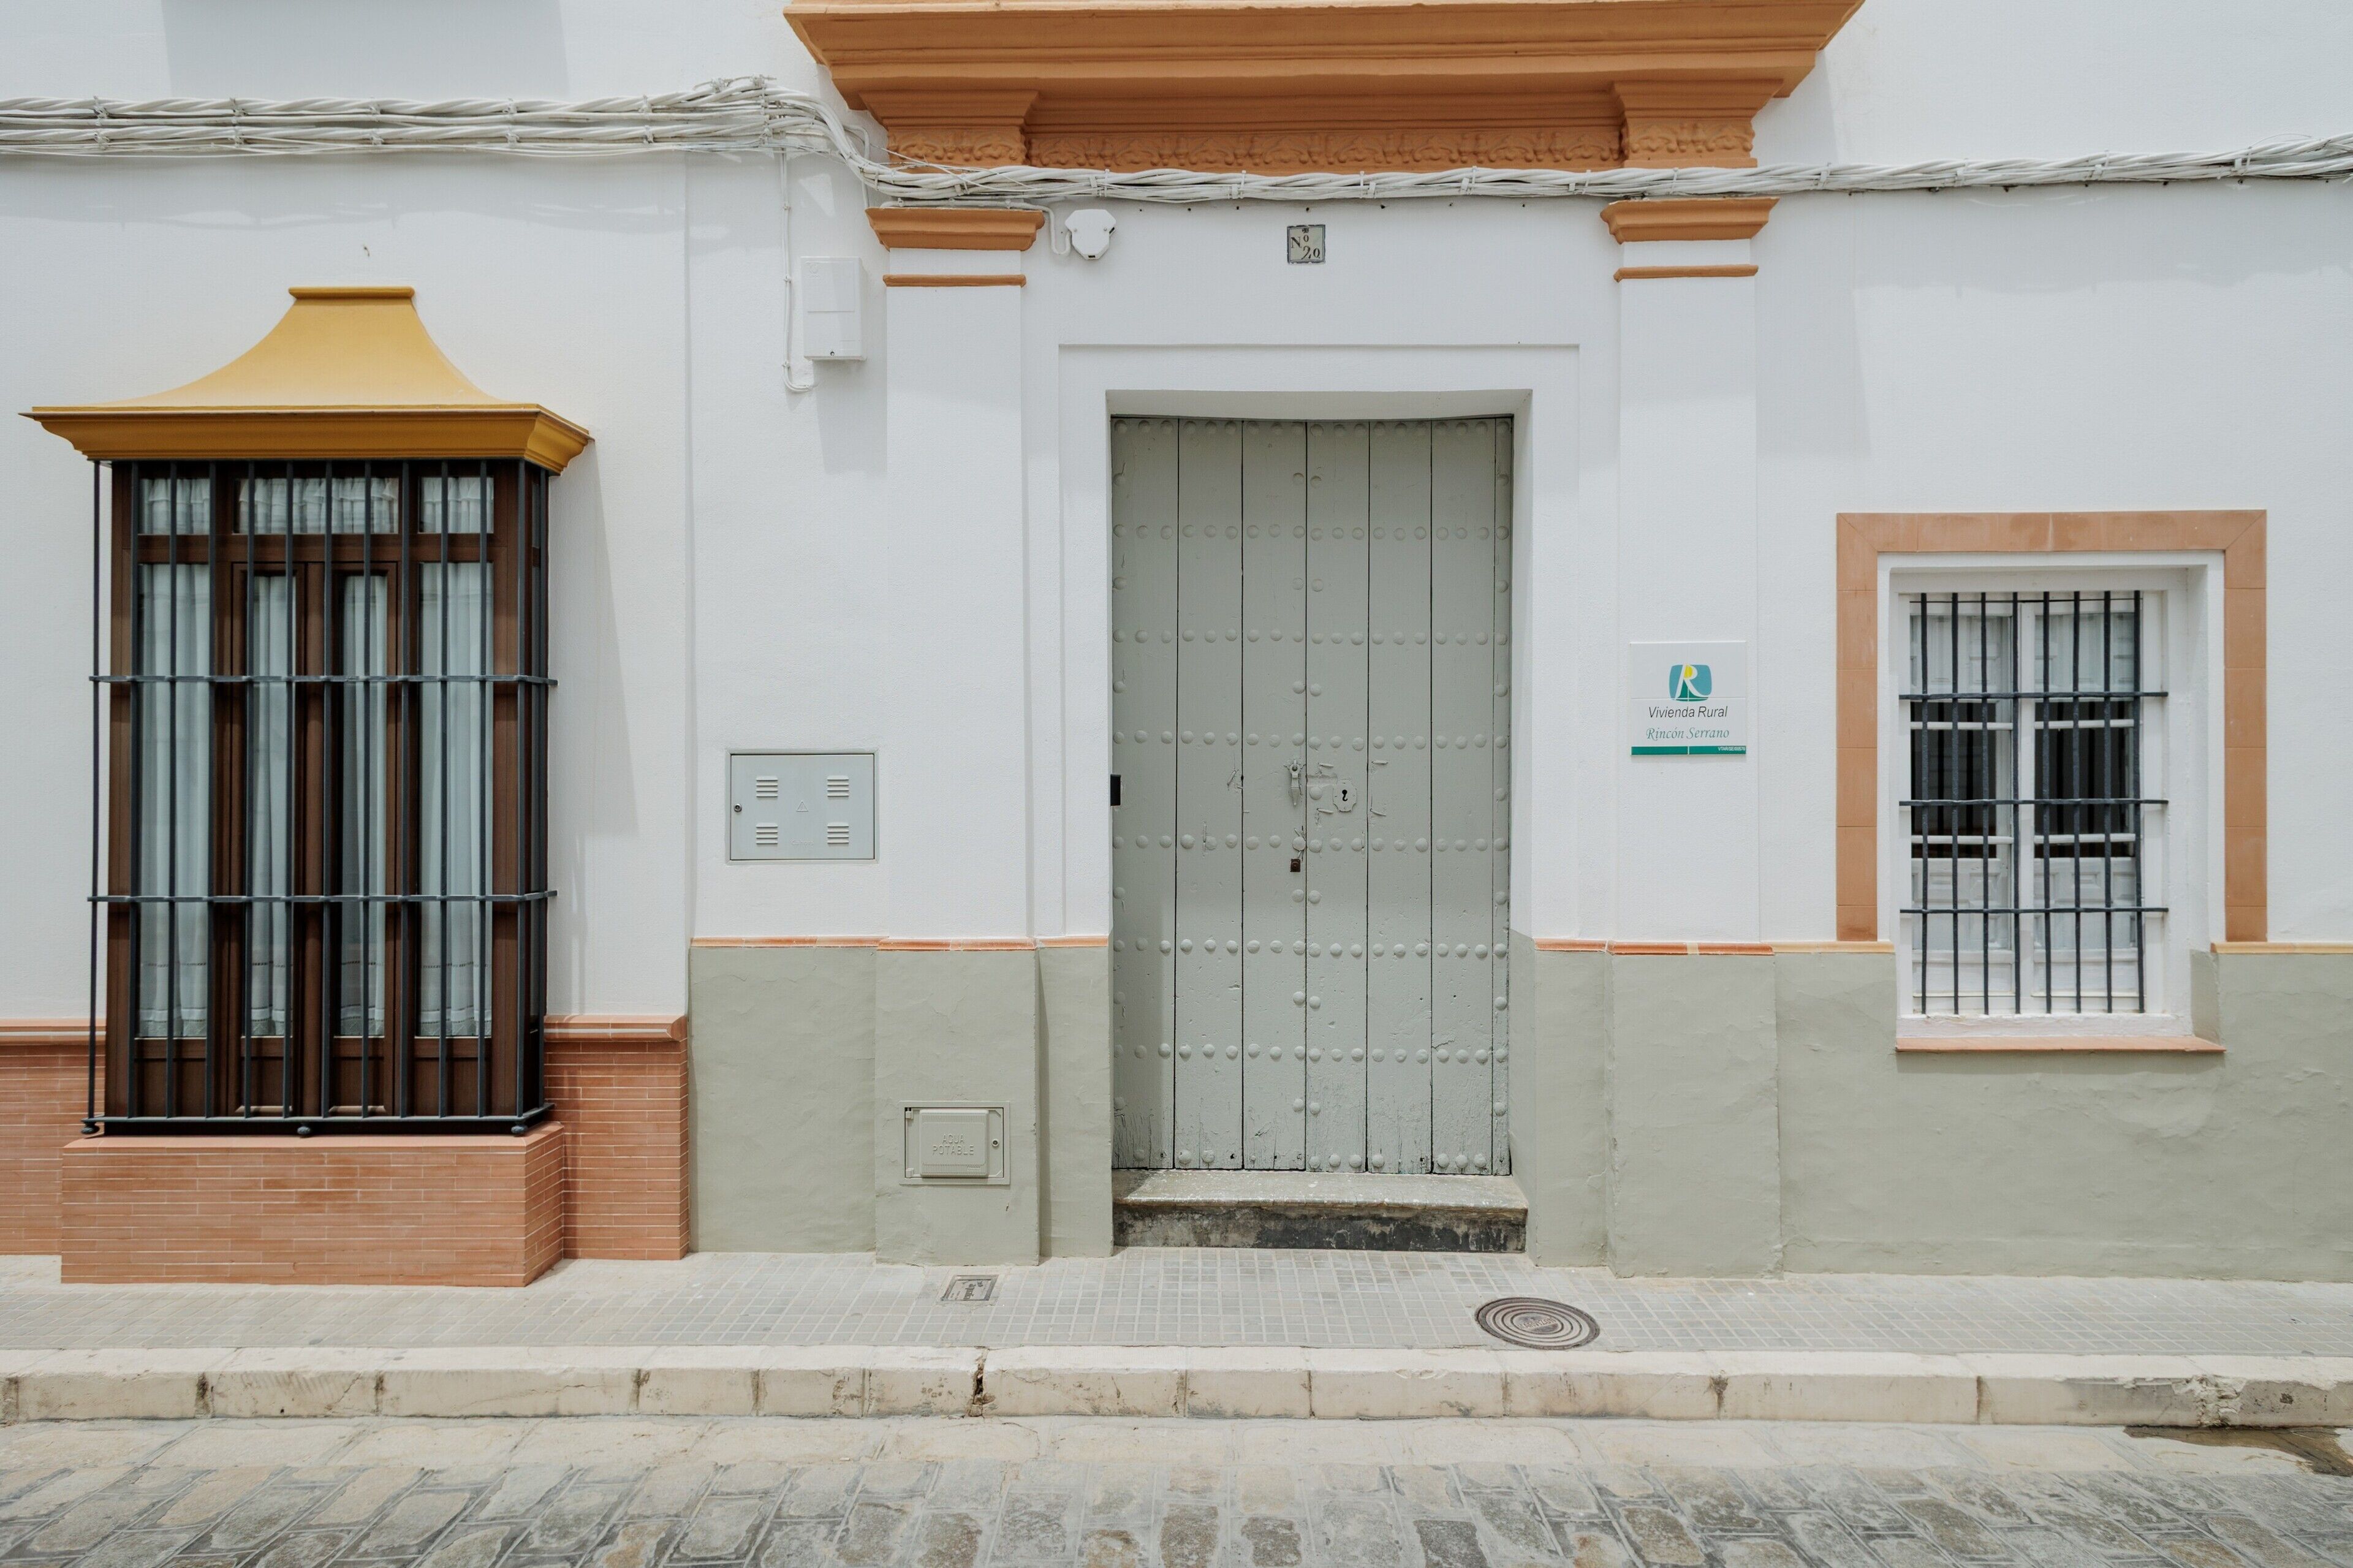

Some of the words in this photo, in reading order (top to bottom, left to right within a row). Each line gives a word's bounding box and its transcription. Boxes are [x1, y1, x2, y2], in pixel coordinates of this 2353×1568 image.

[1648, 706, 1695, 718] Vivienda
[1697, 706, 1728, 718] Rural
[1646, 727, 1684, 741] Rincón
[1686, 727, 1729, 740] Serrano
[942, 1133, 965, 1144] AGUA
[932, 1143, 974, 1155] POTABLE
